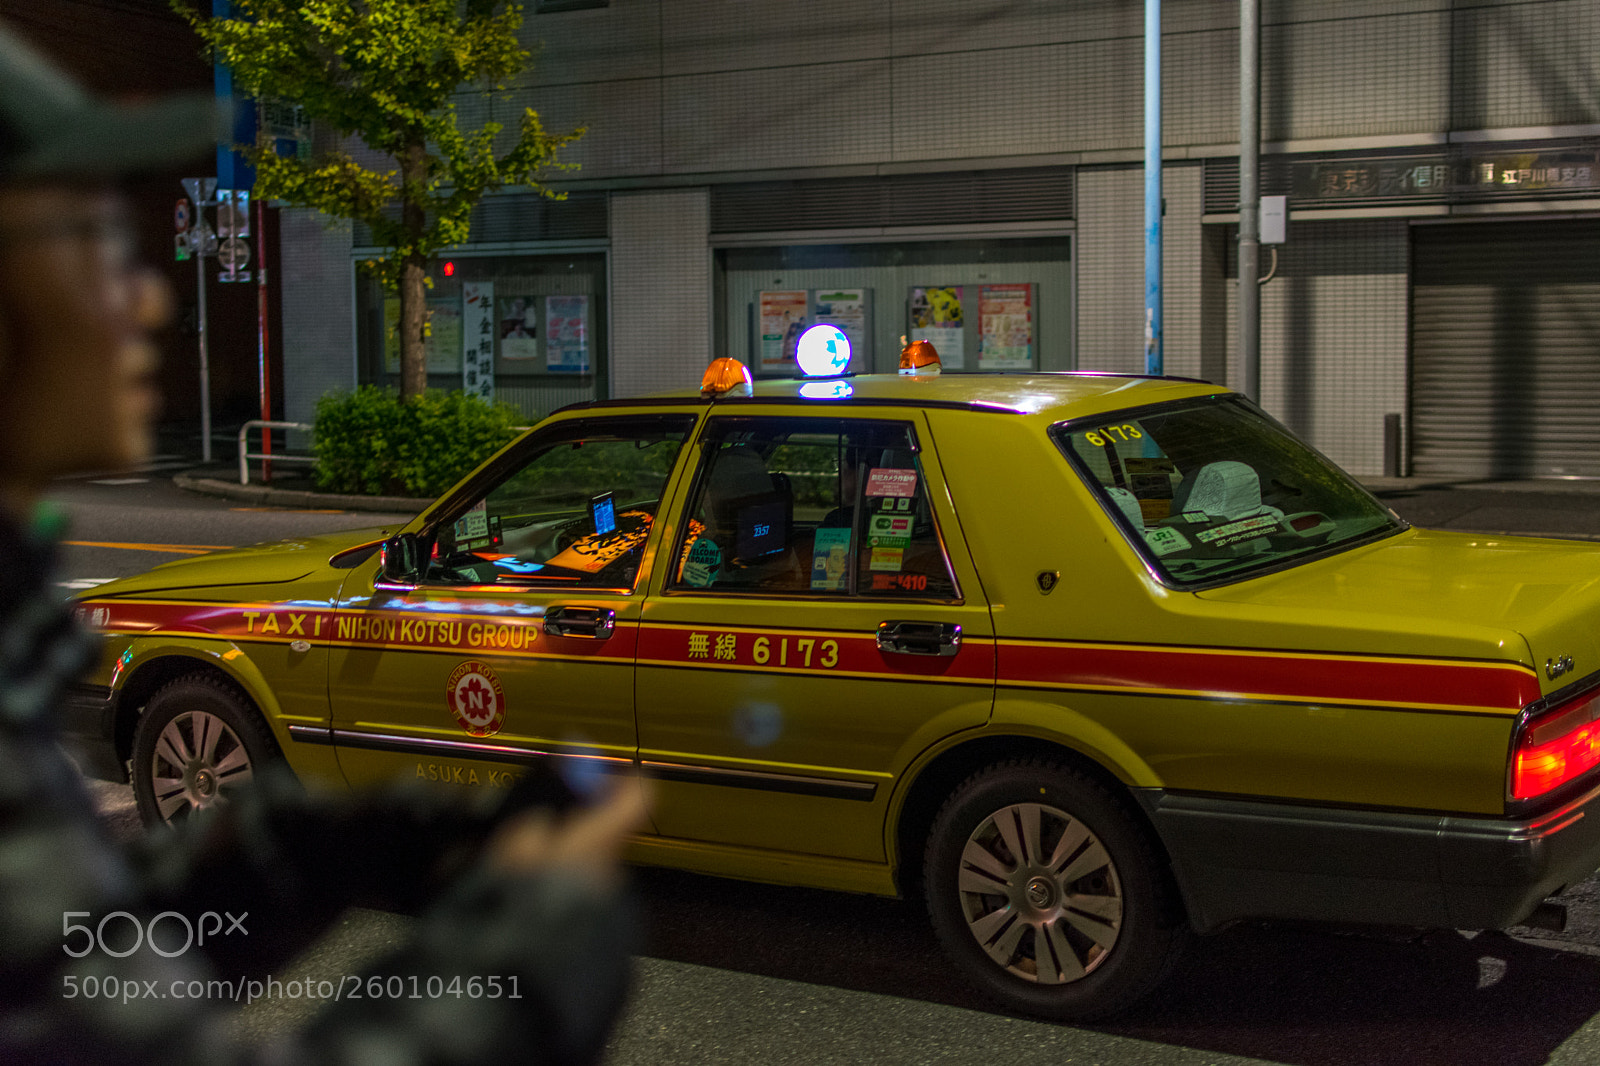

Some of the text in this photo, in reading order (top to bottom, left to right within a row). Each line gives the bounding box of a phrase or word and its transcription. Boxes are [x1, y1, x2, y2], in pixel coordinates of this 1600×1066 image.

[1085, 424, 1142, 446] 6173
[242, 611, 539, 650] TAXI NIHON KOTSU GROUP
[688, 632, 839, 668] 無線 6173
[448, 663, 503, 695] NIHON KOTSU
[415, 762, 481, 786] ASUKA
